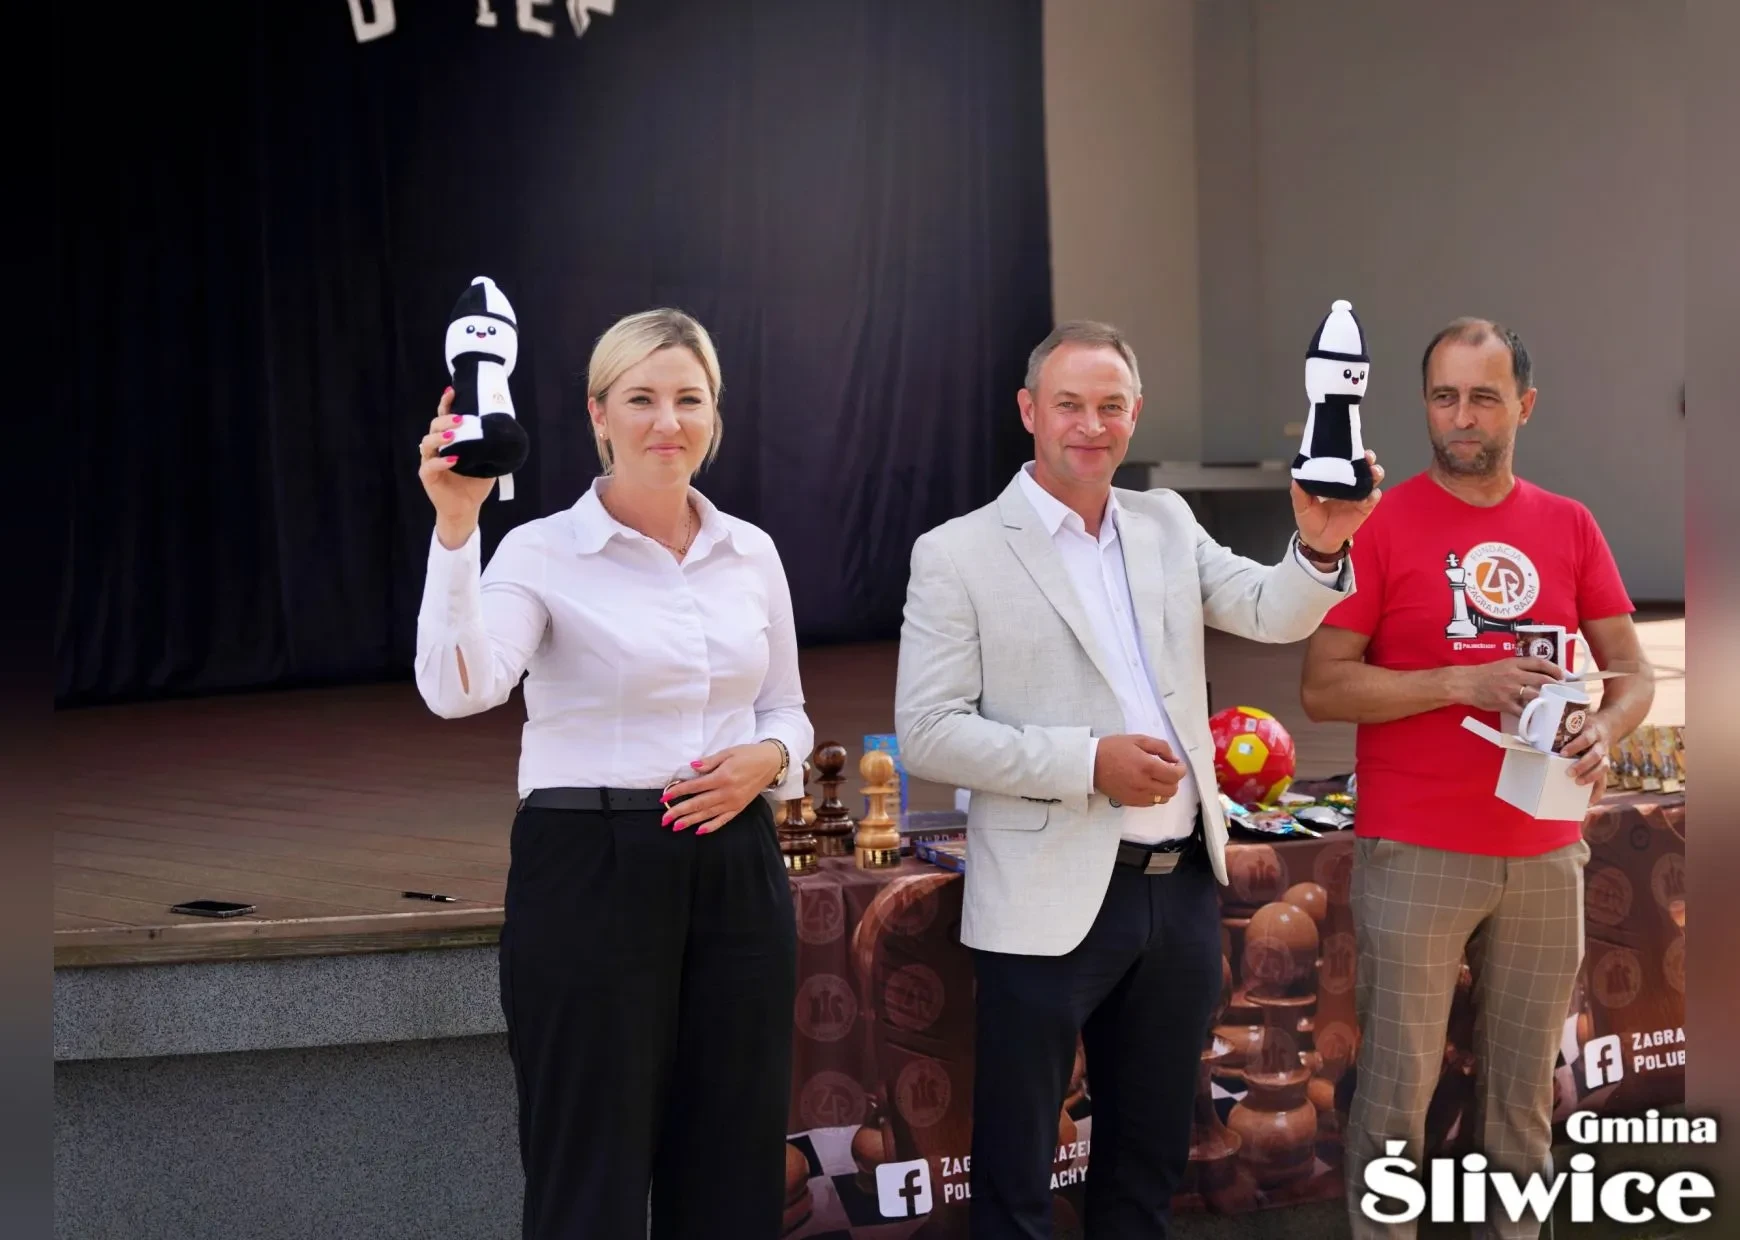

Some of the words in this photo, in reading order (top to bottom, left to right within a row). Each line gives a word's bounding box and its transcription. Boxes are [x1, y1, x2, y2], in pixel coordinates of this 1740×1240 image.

[1470, 545, 1522, 561] FUNDACJA
[1467, 583, 1511, 615] ZAGRAJMY
[1513, 584, 1537, 612] RAZEM
[1631, 1027, 1685, 1051] ZAGRA
[1633, 1050, 1685, 1073] POLUB
[940, 1155, 971, 1177] ZAG
[943, 1182, 972, 1204] POL
[1050, 1166, 1088, 1190] ACHY
